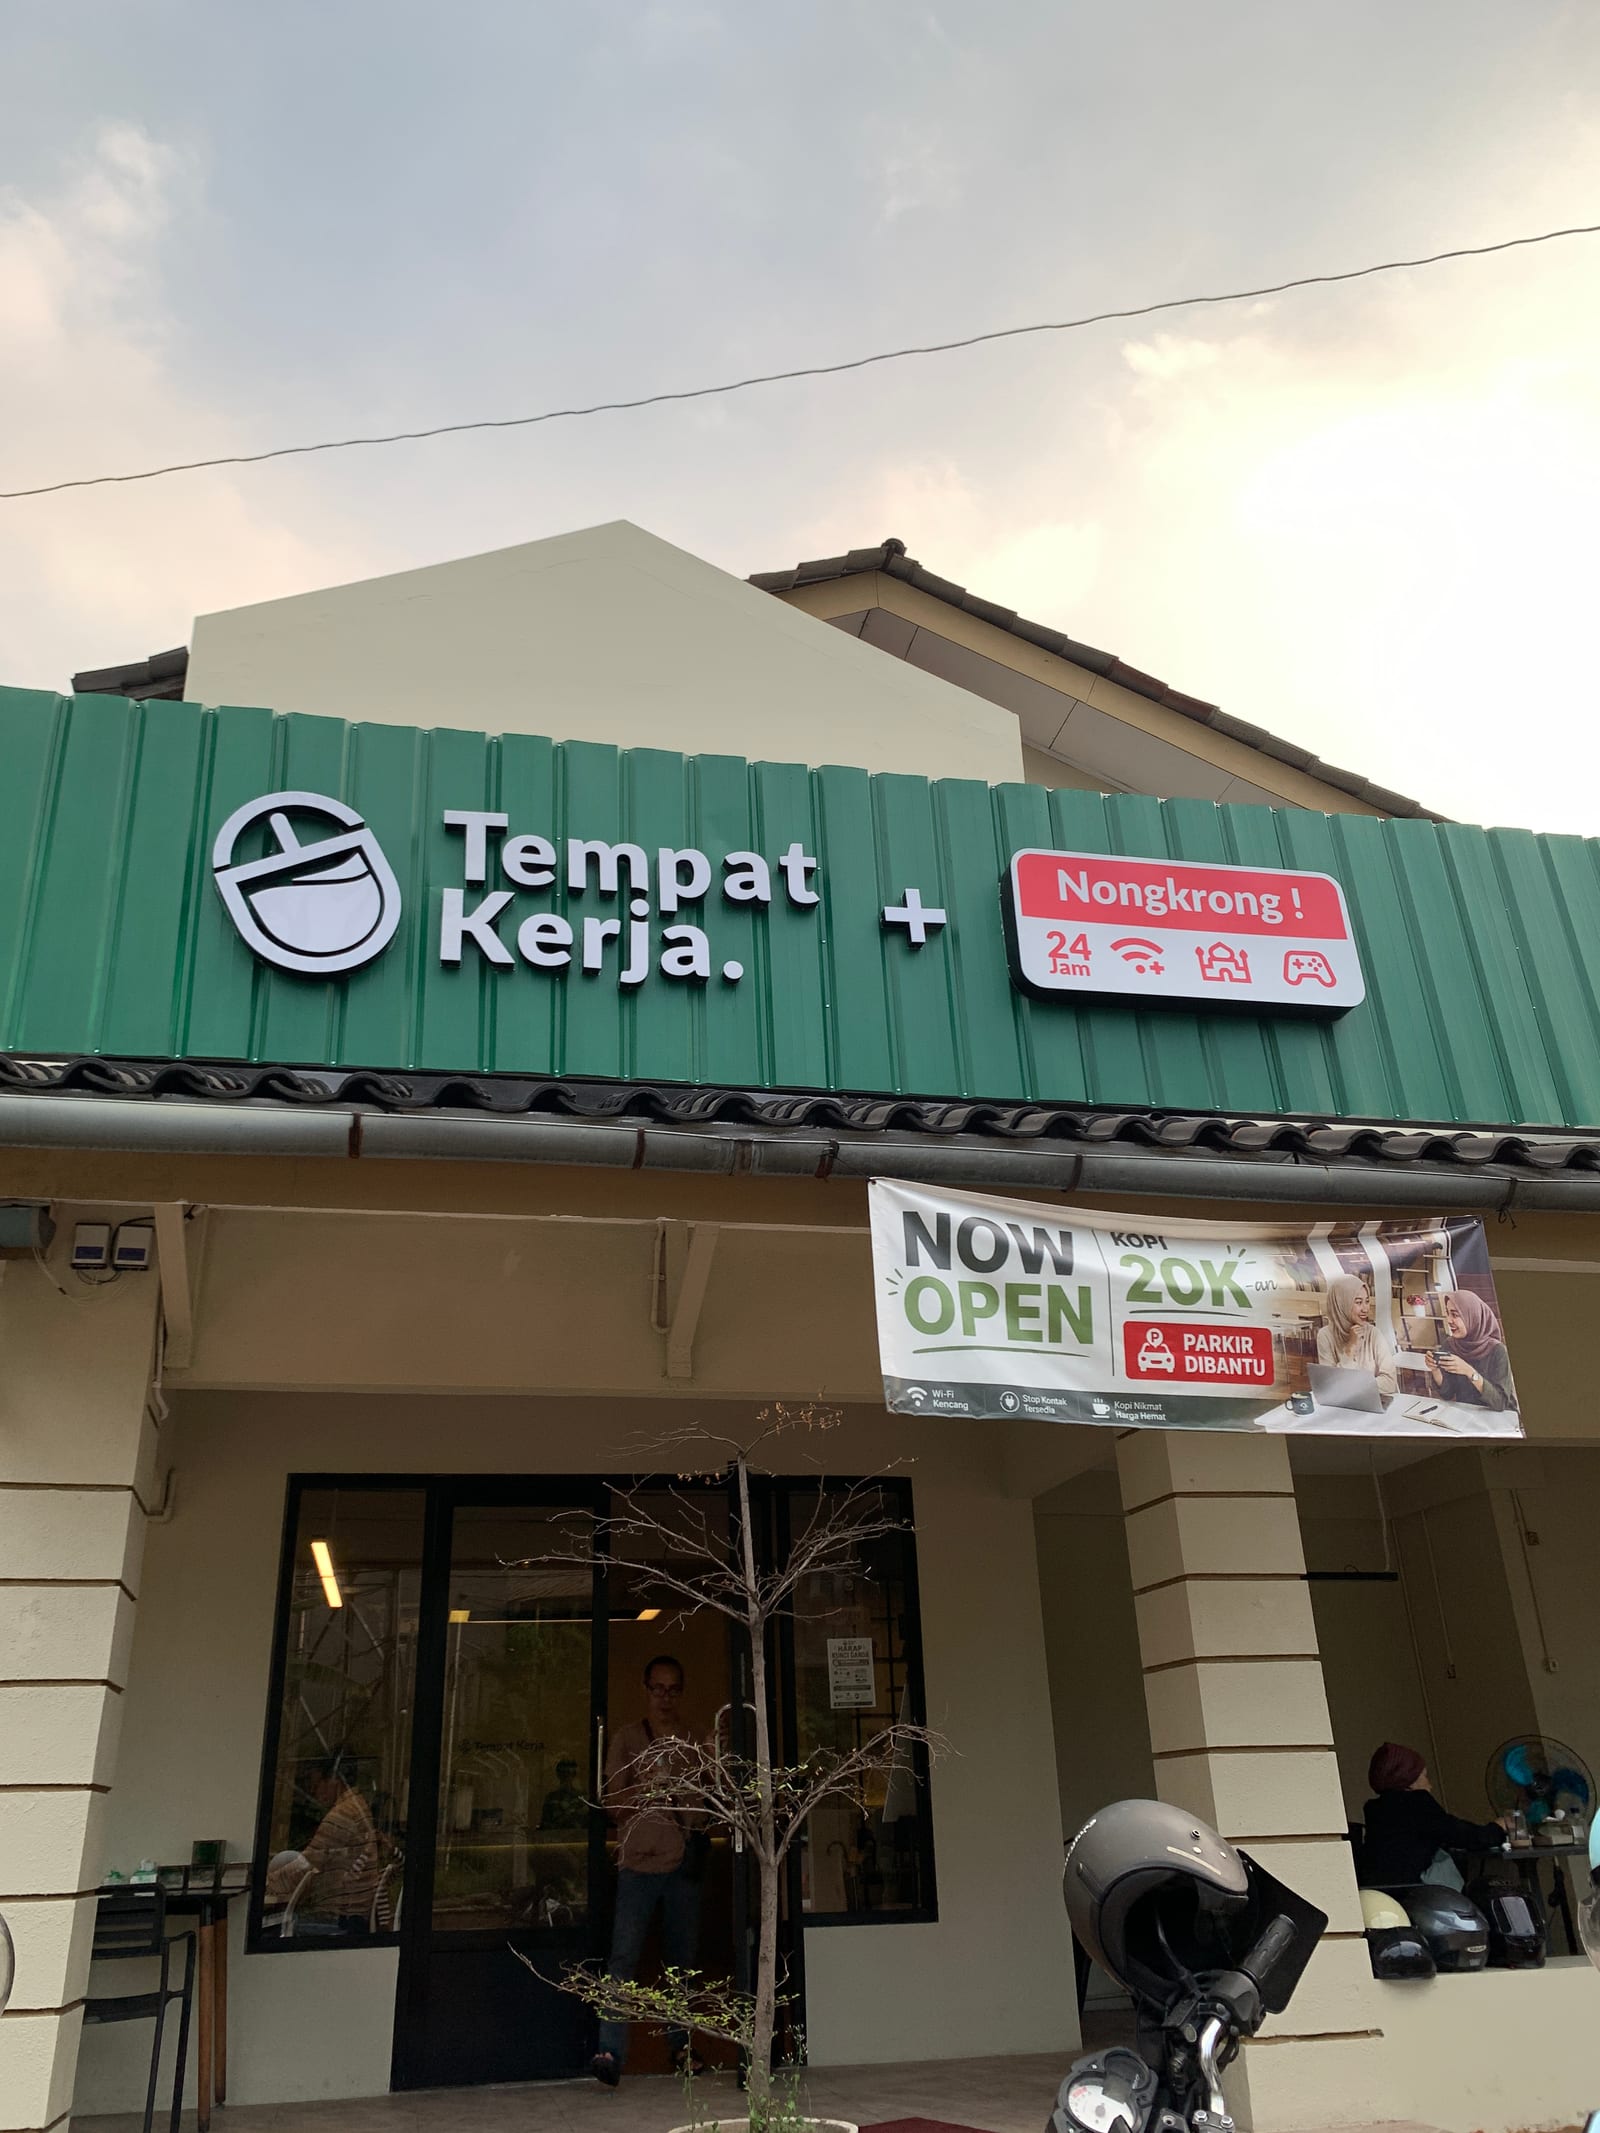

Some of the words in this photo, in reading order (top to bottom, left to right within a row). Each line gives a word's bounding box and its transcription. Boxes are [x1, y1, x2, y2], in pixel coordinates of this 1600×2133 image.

[442, 809, 820, 917] Tempat
[440, 888, 744, 987] Kerja.
[1046, 930, 1092, 961] 24
[1049, 957, 1091, 976] Jam
[902, 1211, 1074, 1276] NOW
[1110, 1231, 1167, 1251] KOPI
[904, 1275, 1094, 1345] OPEN
[1184, 1333, 1253, 1355] PARKIR
[1185, 1355, 1266, 1377] DIBANTU
[932, 1389, 955, 1398] Wi-Fi
[1022, 1394, 1040, 1405] Stop
[1041, 1395, 1067, 1406] Kontak
[933, 1400, 969, 1411] Kencang
[1024, 1405, 1056, 1415] Tersedia
[1114, 1401, 1132, 1412] Kopi
[1134, 1402, 1162, 1411] Nikmat
[1115, 1410, 1139, 1421] Harga
[1141, 1411, 1166, 1420] Hemat
